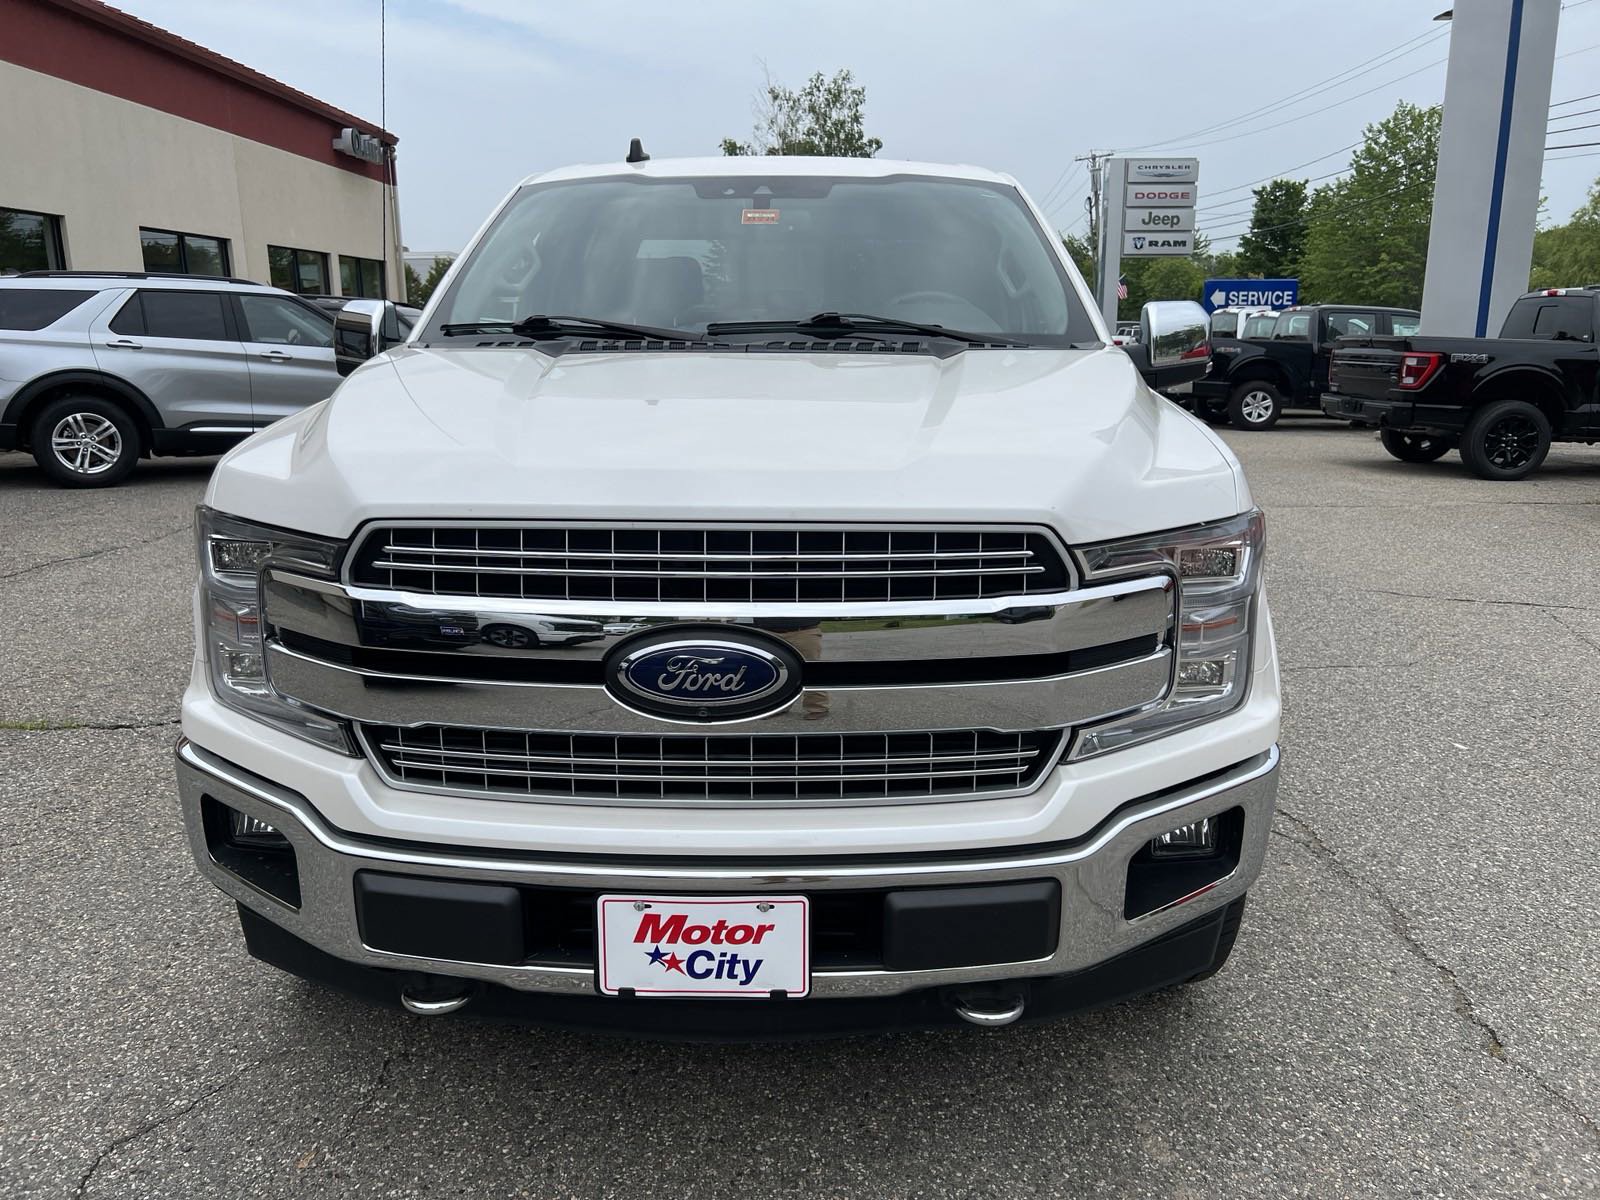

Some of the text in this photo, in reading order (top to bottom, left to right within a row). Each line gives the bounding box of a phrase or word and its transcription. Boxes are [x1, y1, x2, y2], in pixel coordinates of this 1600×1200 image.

[1134, 191, 1191, 200] DODGE
[1141, 211, 1181, 228] Jeep
[1147, 239, 1187, 248] RAM
[1228, 290, 1293, 306] SERVICE
[1450, 353, 1489, 364] FX4
[657, 654, 748, 692] Ford
[633, 913, 775, 945] Motor
[685, 949, 764, 986] City
